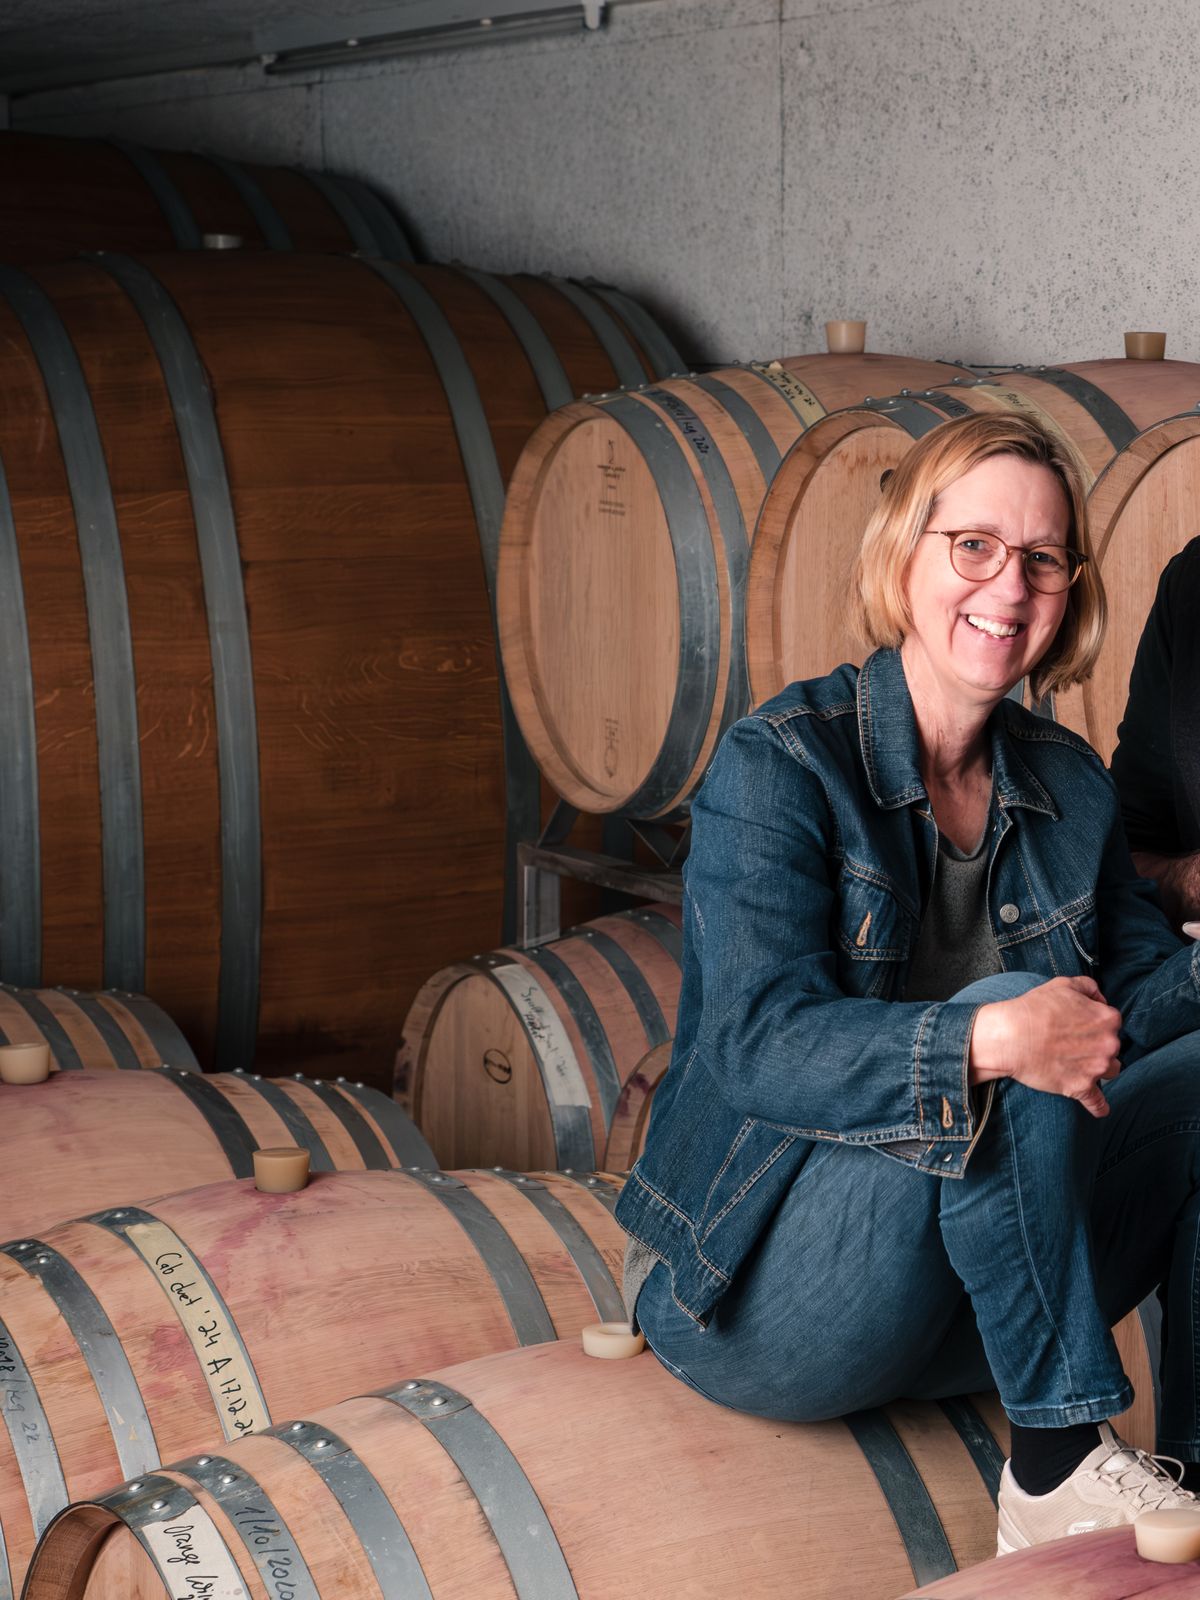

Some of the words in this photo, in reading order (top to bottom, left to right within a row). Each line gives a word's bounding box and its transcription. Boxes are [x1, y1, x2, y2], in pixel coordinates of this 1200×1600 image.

[156, 1252, 183, 1275] Cab
[207, 1357, 233, 1376] A
[22, 1421, 40, 1445] 22
[163, 1525, 201, 1565] Orange
